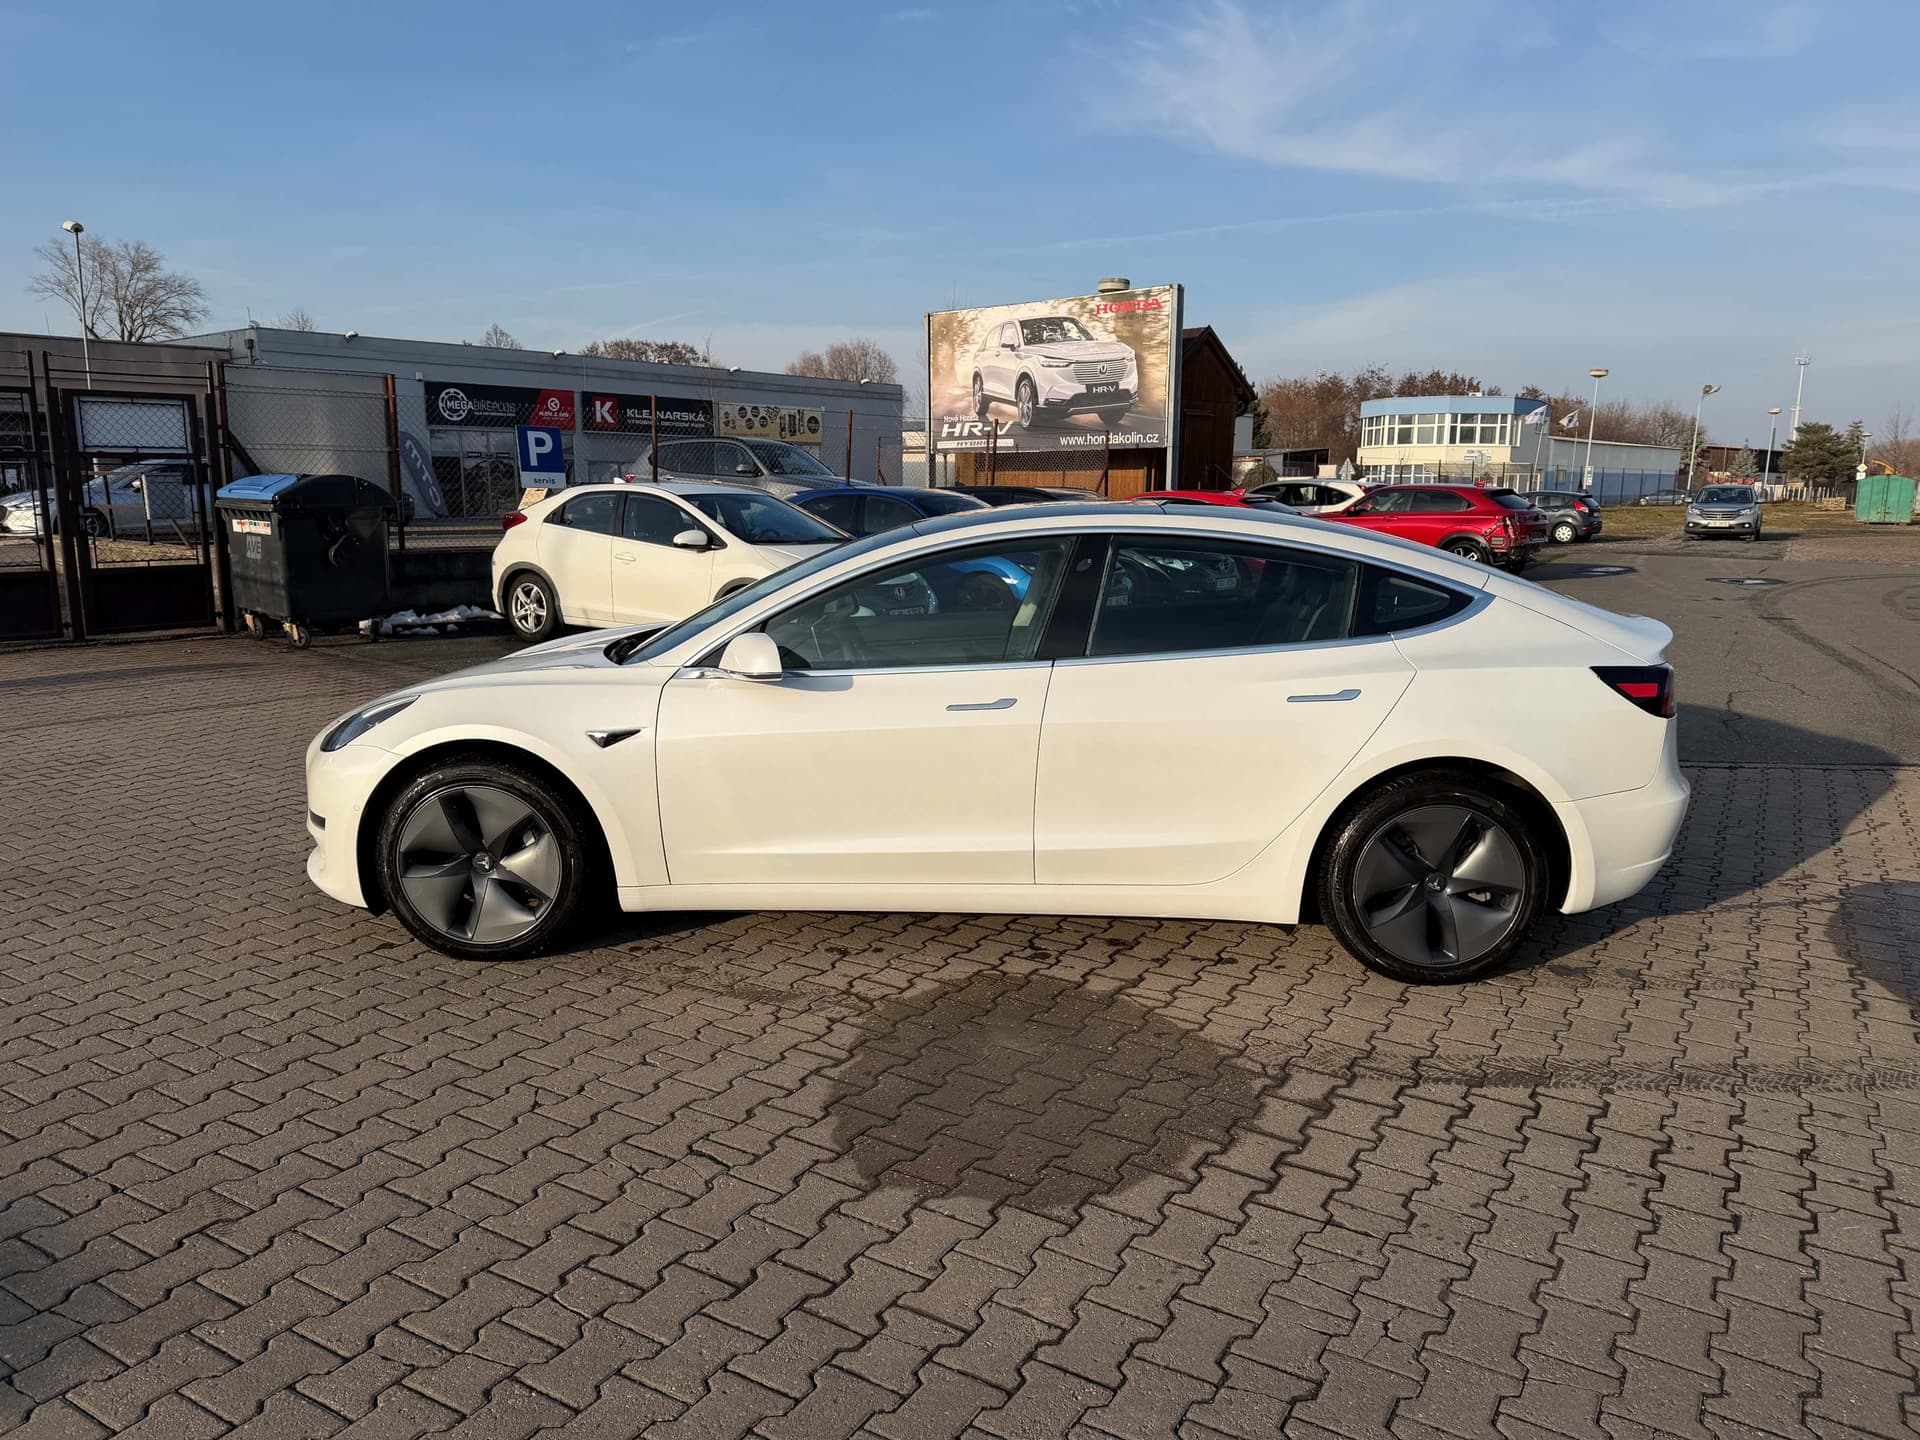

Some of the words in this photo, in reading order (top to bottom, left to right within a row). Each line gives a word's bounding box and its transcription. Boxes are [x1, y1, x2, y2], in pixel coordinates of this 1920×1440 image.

[1095, 297, 1163, 317] HONDA
[1092, 385, 1117, 394] HR-V
[595, 400, 615, 423] K
[626, 408, 705, 421] KLENARSKÁ
[941, 420, 1015, 438] HR-V
[526, 430, 553, 467] P
[533, 477, 556, 485] servis
